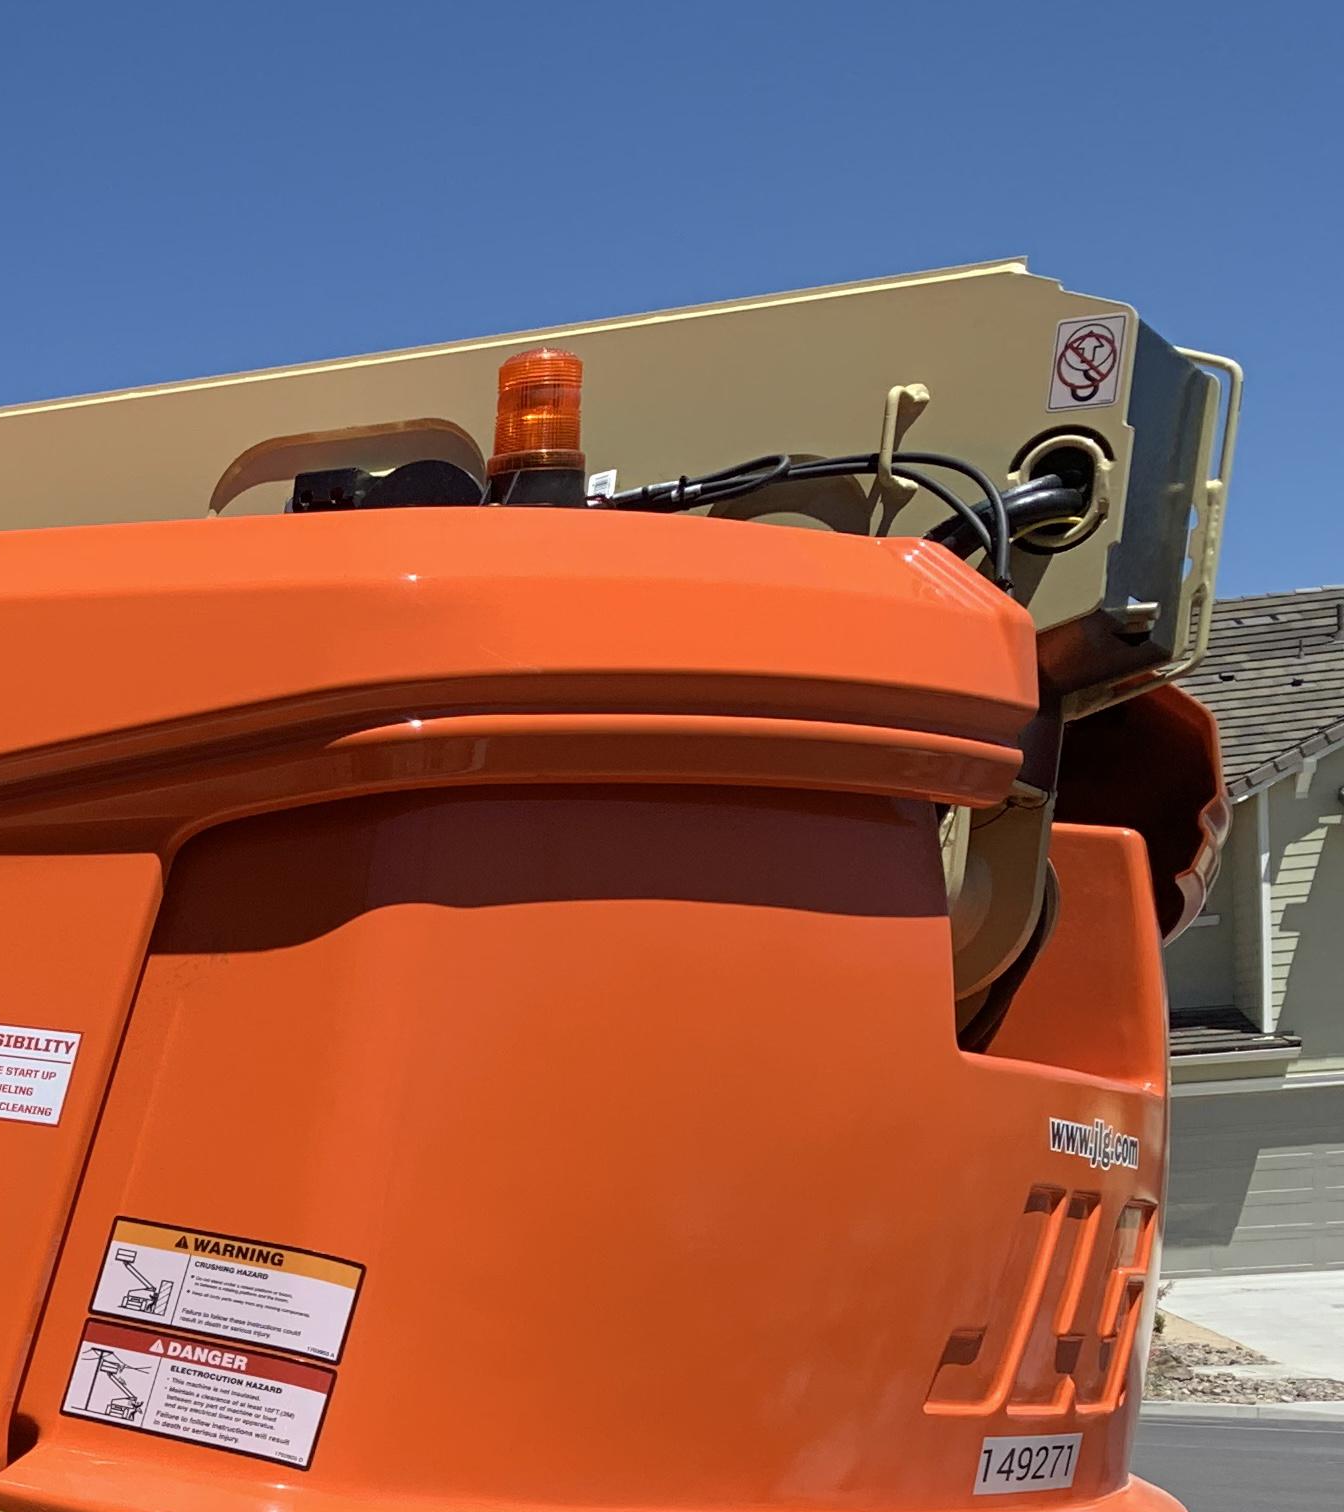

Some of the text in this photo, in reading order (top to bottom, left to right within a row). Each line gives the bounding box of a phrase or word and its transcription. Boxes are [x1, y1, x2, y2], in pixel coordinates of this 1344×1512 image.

[4, 1065, 39, 1078] START
[40, 1069, 57, 1080] UP
[1050, 1117, 1139, 1169] www.jlg.com
[194, 1237, 285, 1267] WARNING
[193, 1259, 269, 1281] CRUSHING HAZARD
[166, 1341, 249, 1371] DANGER
[169, 1363, 283, 1396] ELECTROCUTION HAZARD
[982, 1443, 1076, 1483] 149271
